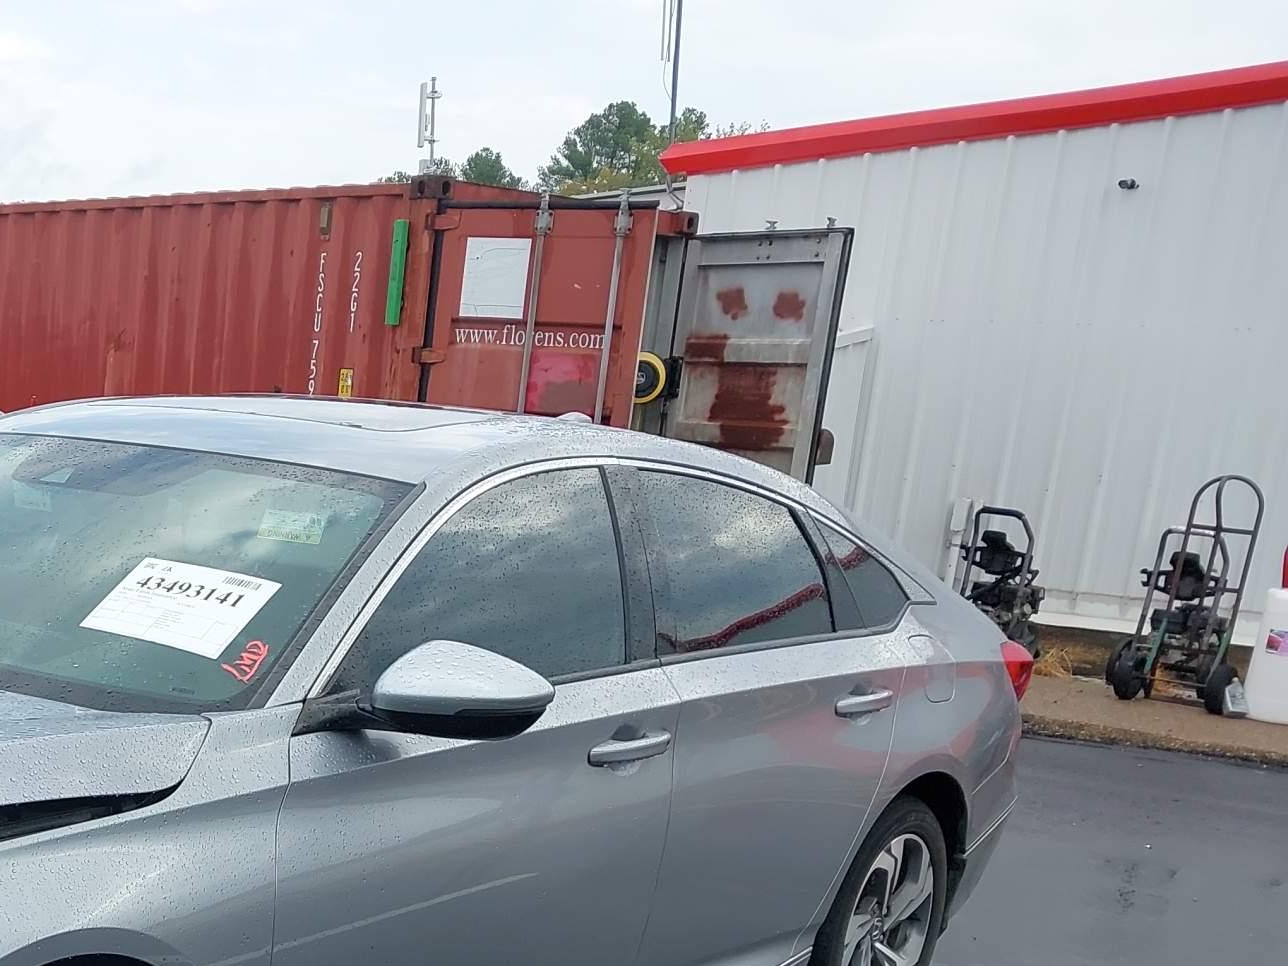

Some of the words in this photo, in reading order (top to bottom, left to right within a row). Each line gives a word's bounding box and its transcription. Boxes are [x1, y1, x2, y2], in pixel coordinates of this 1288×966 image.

[314, 252, 327, 333] FSCU
[350, 251, 362, 333] 22G1
[455, 324, 605, 350] www.floens.com
[136, 575, 245, 608] 43493141
